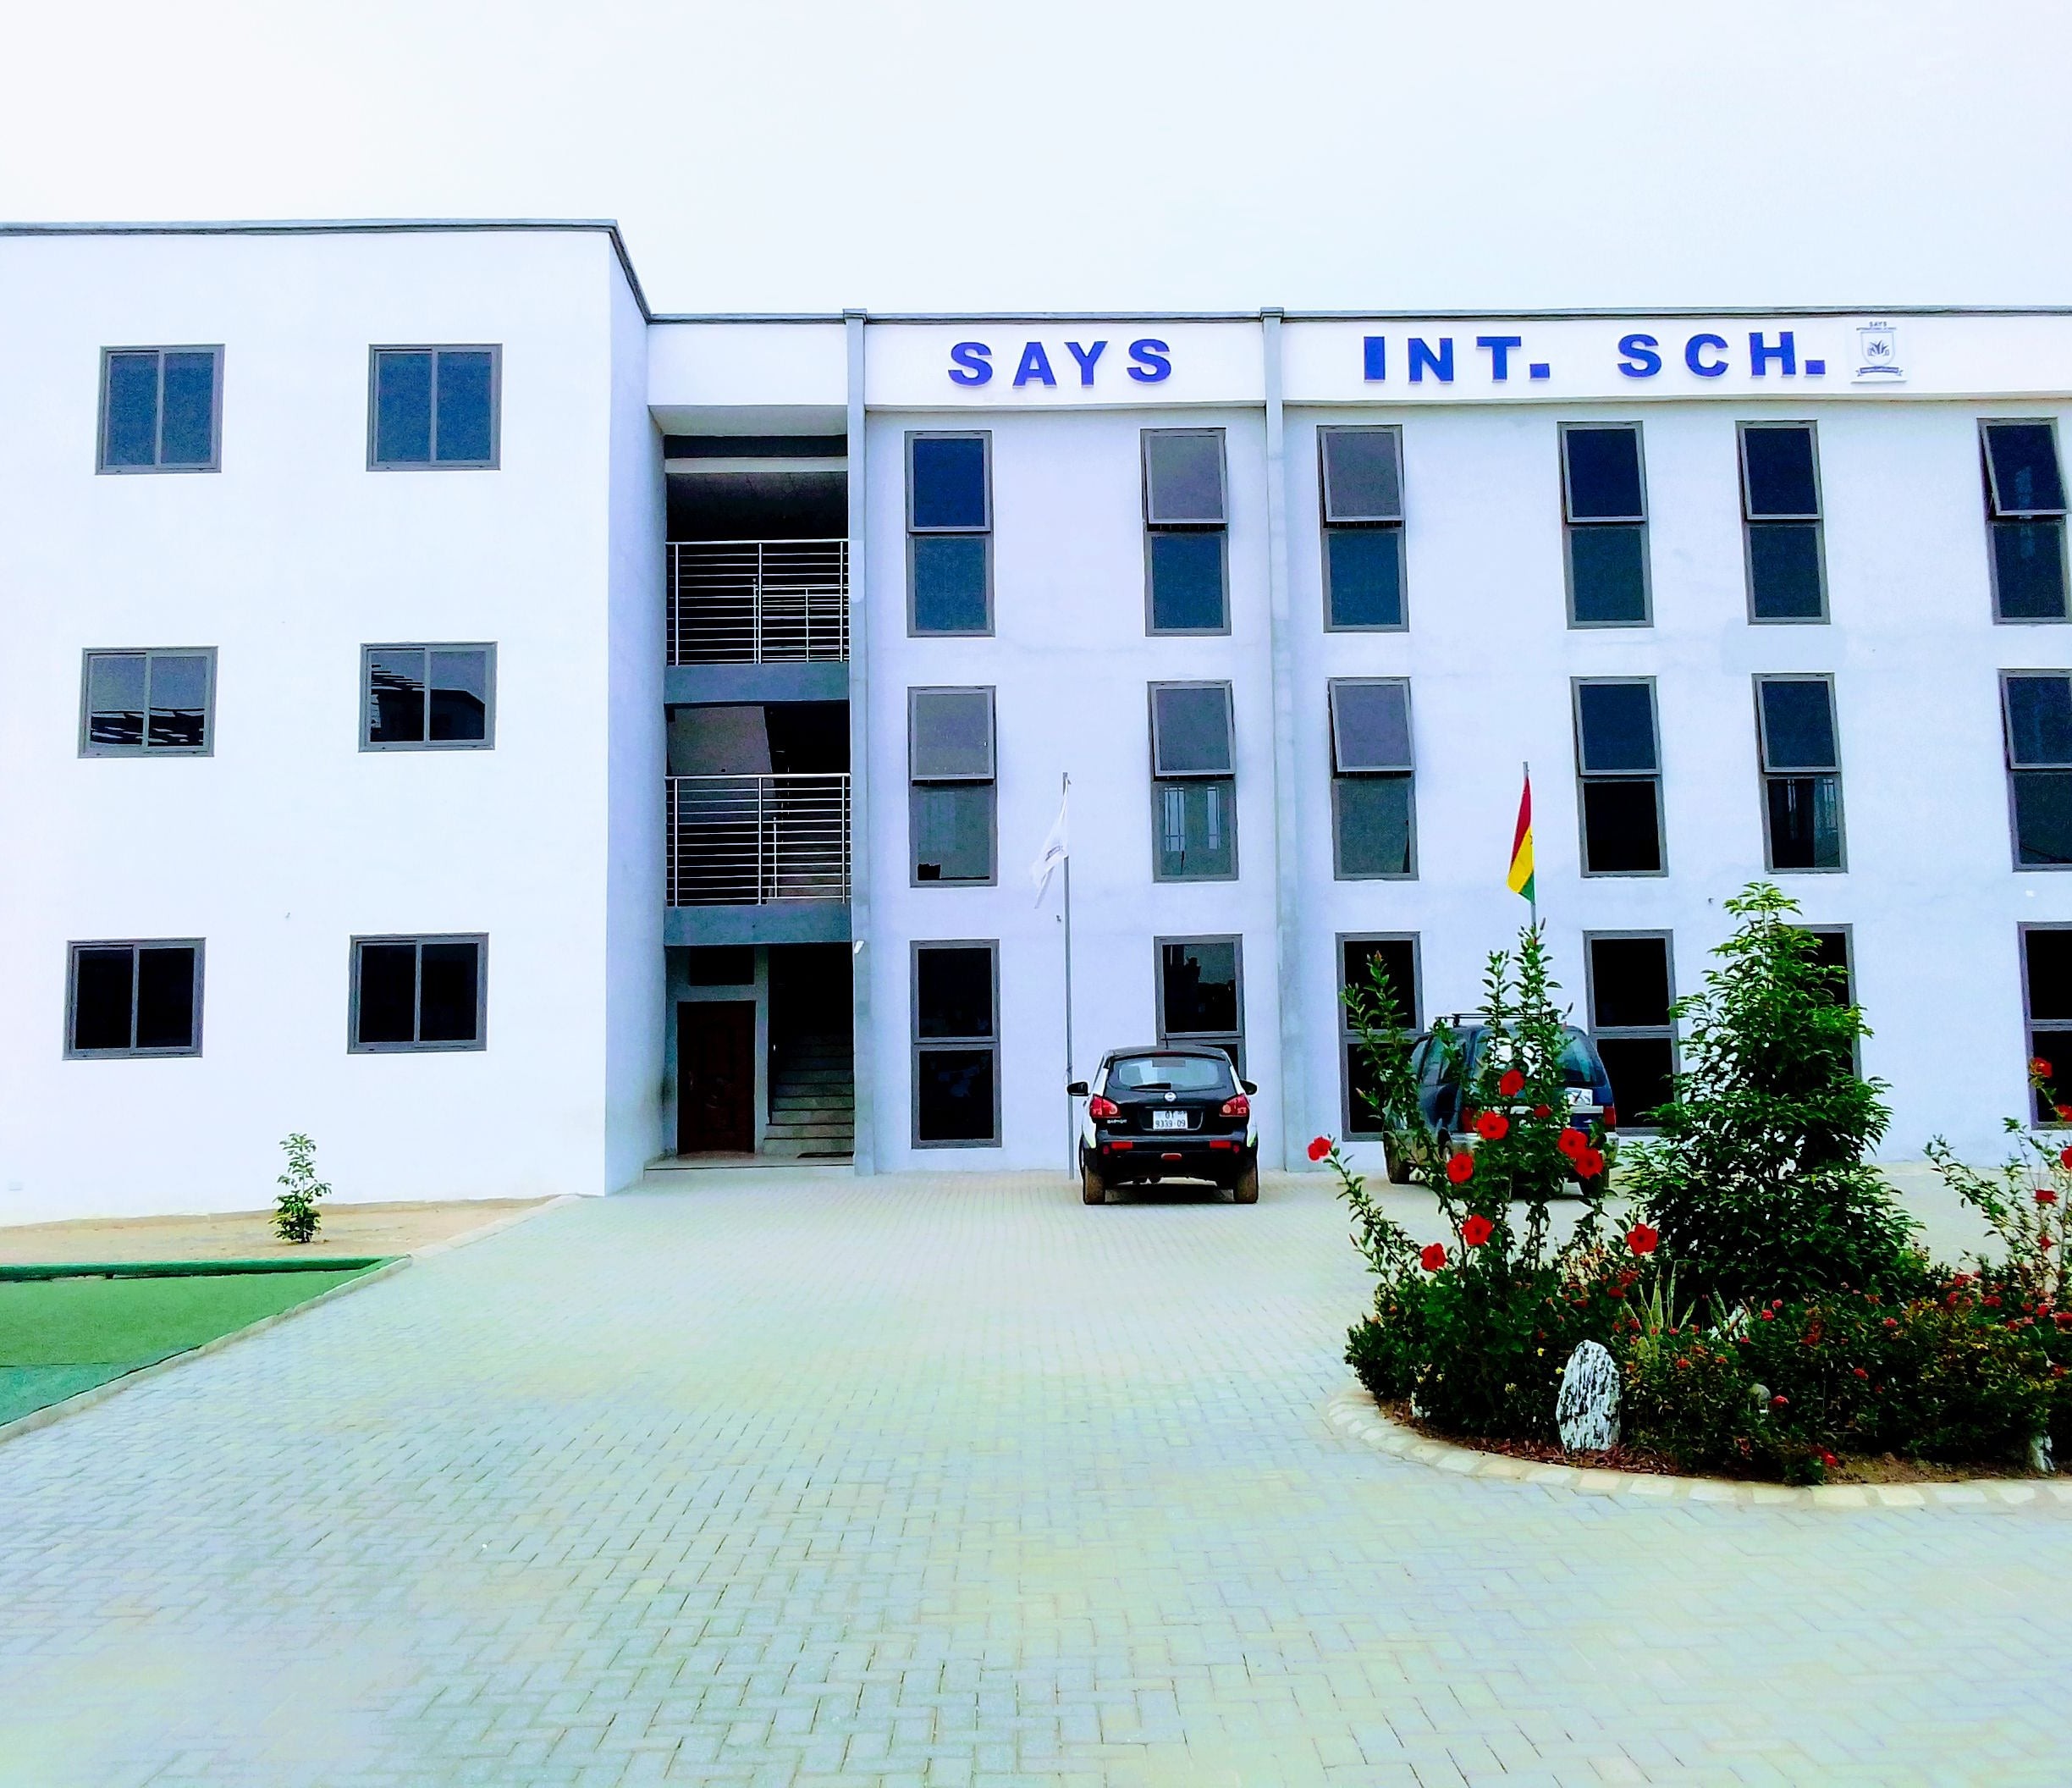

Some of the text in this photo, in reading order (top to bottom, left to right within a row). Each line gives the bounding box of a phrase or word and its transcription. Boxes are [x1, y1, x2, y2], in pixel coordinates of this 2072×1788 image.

[947, 332, 1827, 387] SAYS INT. SCH.
